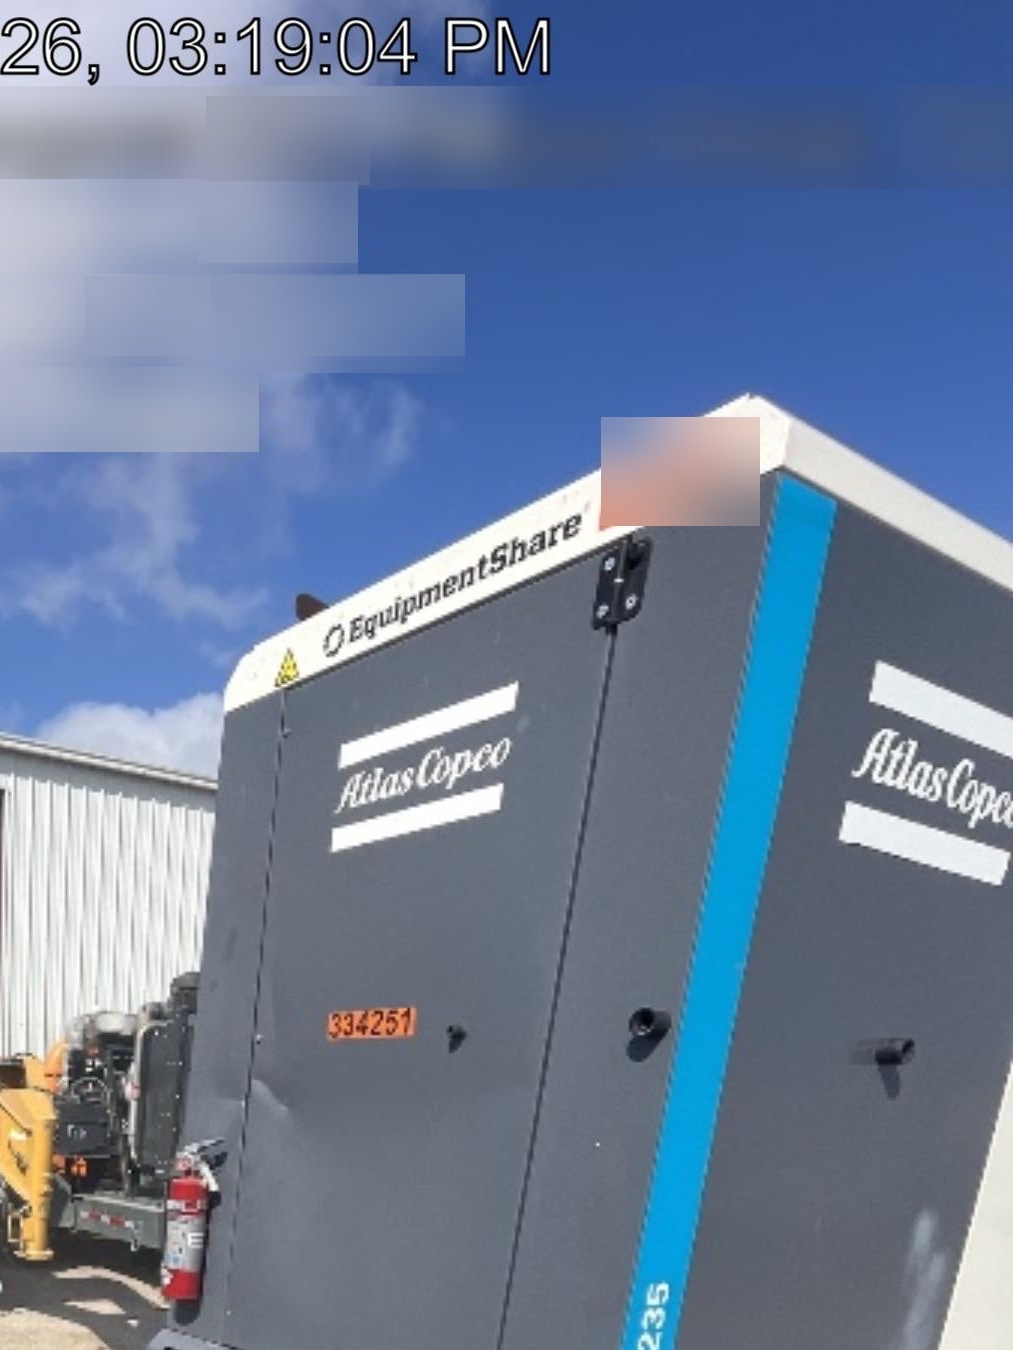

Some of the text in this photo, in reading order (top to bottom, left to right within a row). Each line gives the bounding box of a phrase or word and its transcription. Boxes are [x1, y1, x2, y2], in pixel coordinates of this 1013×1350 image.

[348, 513, 582, 643] EquipmentShare
[334, 737, 512, 814] Atlas Copco
[851, 728, 948, 803] Atlas
[329, 1007, 412, 1038] 334251
